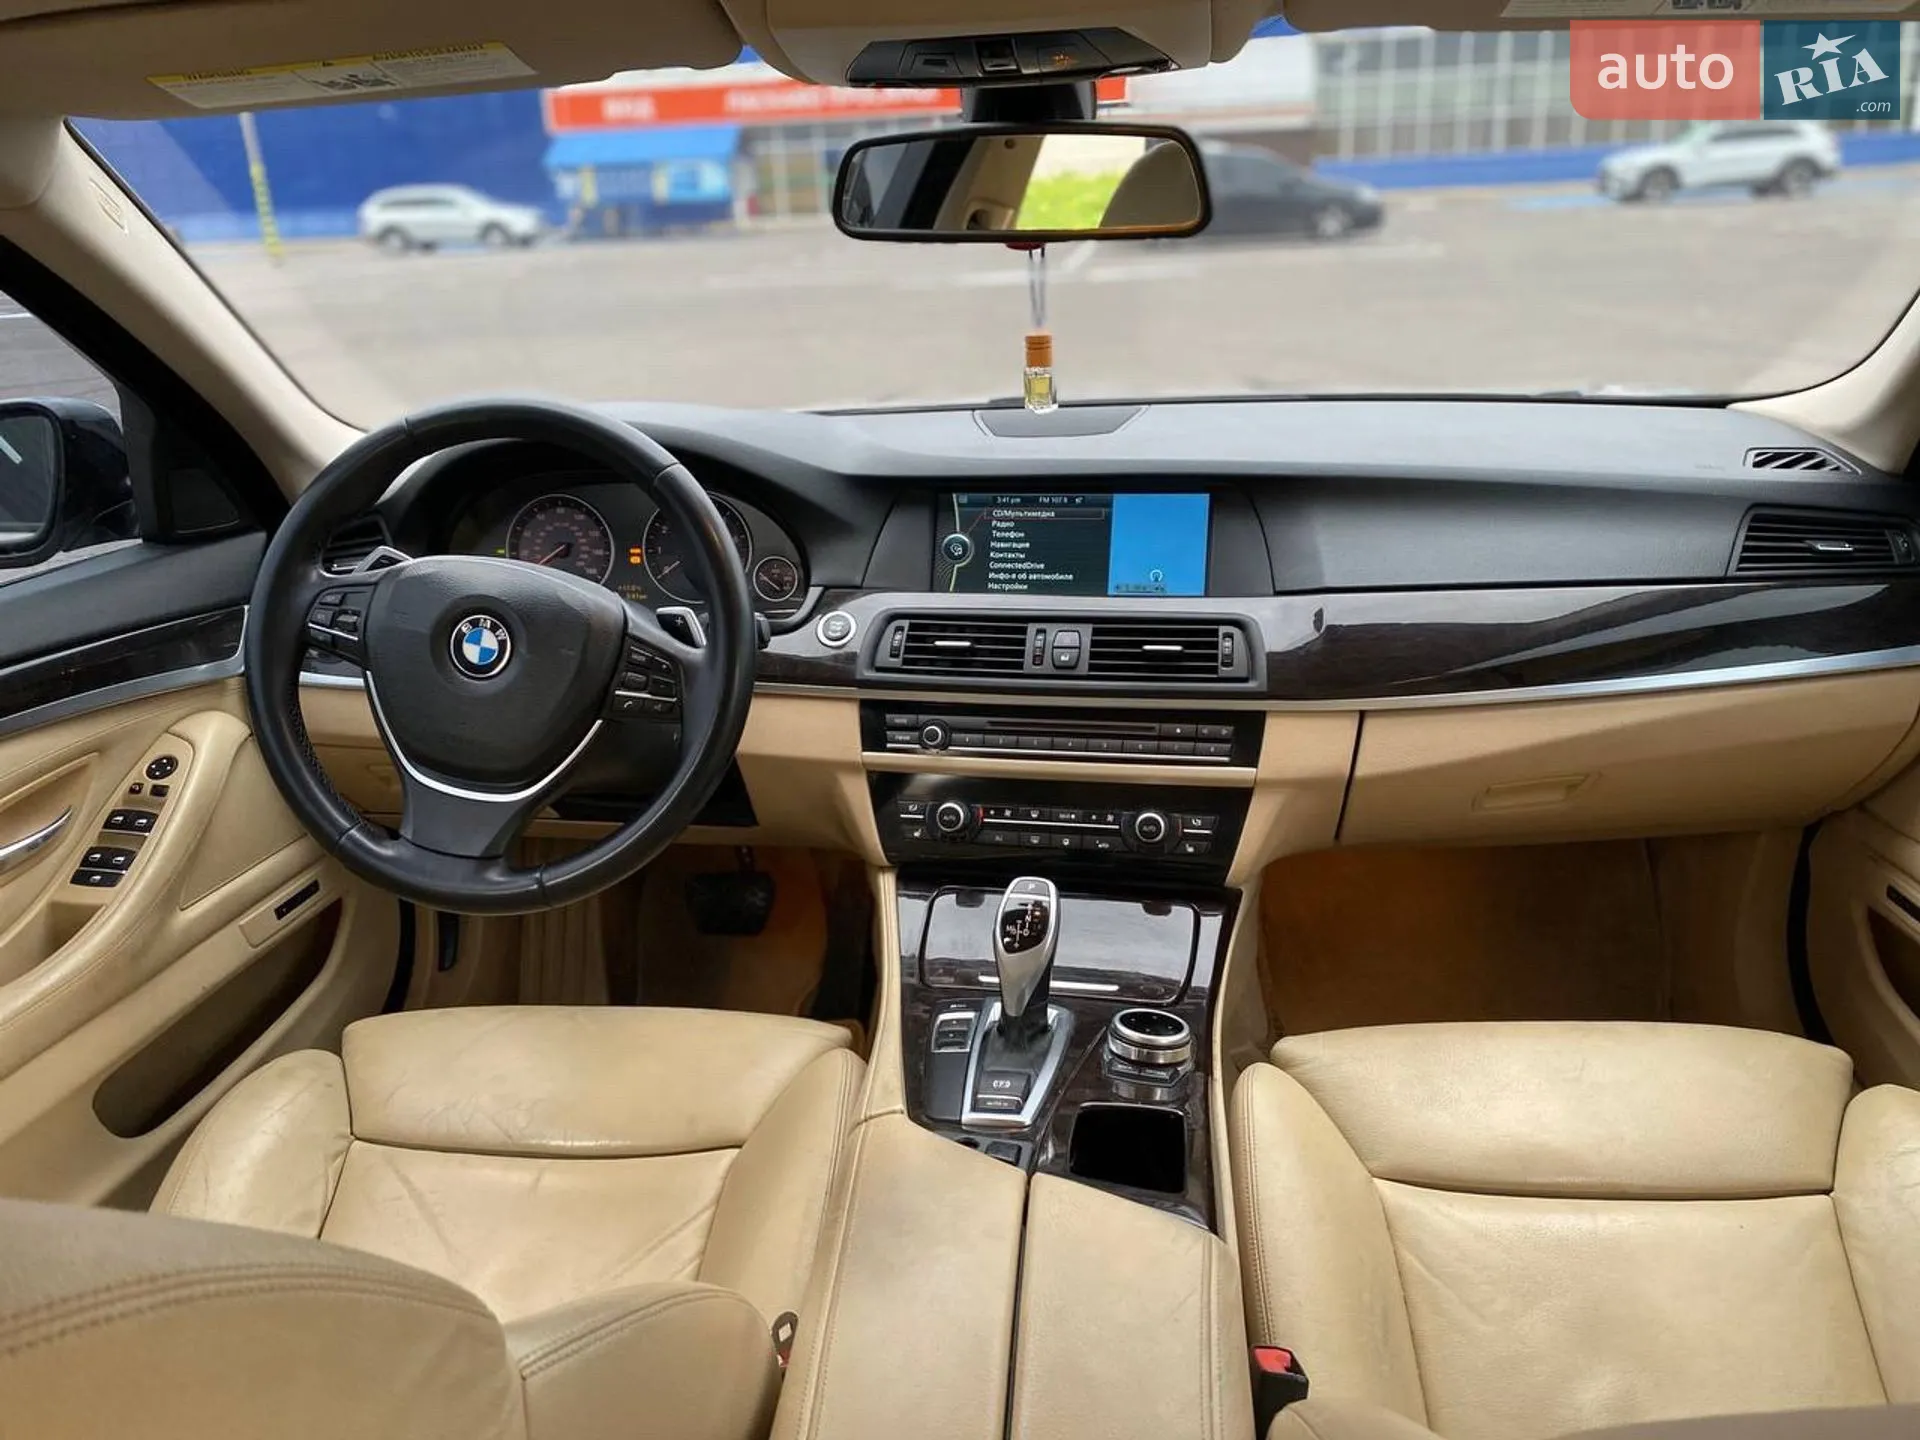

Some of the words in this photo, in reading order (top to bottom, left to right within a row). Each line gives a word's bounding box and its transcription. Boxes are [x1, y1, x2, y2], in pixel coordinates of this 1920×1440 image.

[992, 530, 1025, 538] Телефон
[990, 540, 1030, 549] Навигация
[989, 551, 1026, 559] Контакты
[989, 561, 1045, 569] ConnectedDrive
[1017, 572, 1027, 580] об
[1028, 573, 1074, 581] автомобиле
[987, 583, 1028, 591] Настройки
[460, 618, 507, 640] BMW
